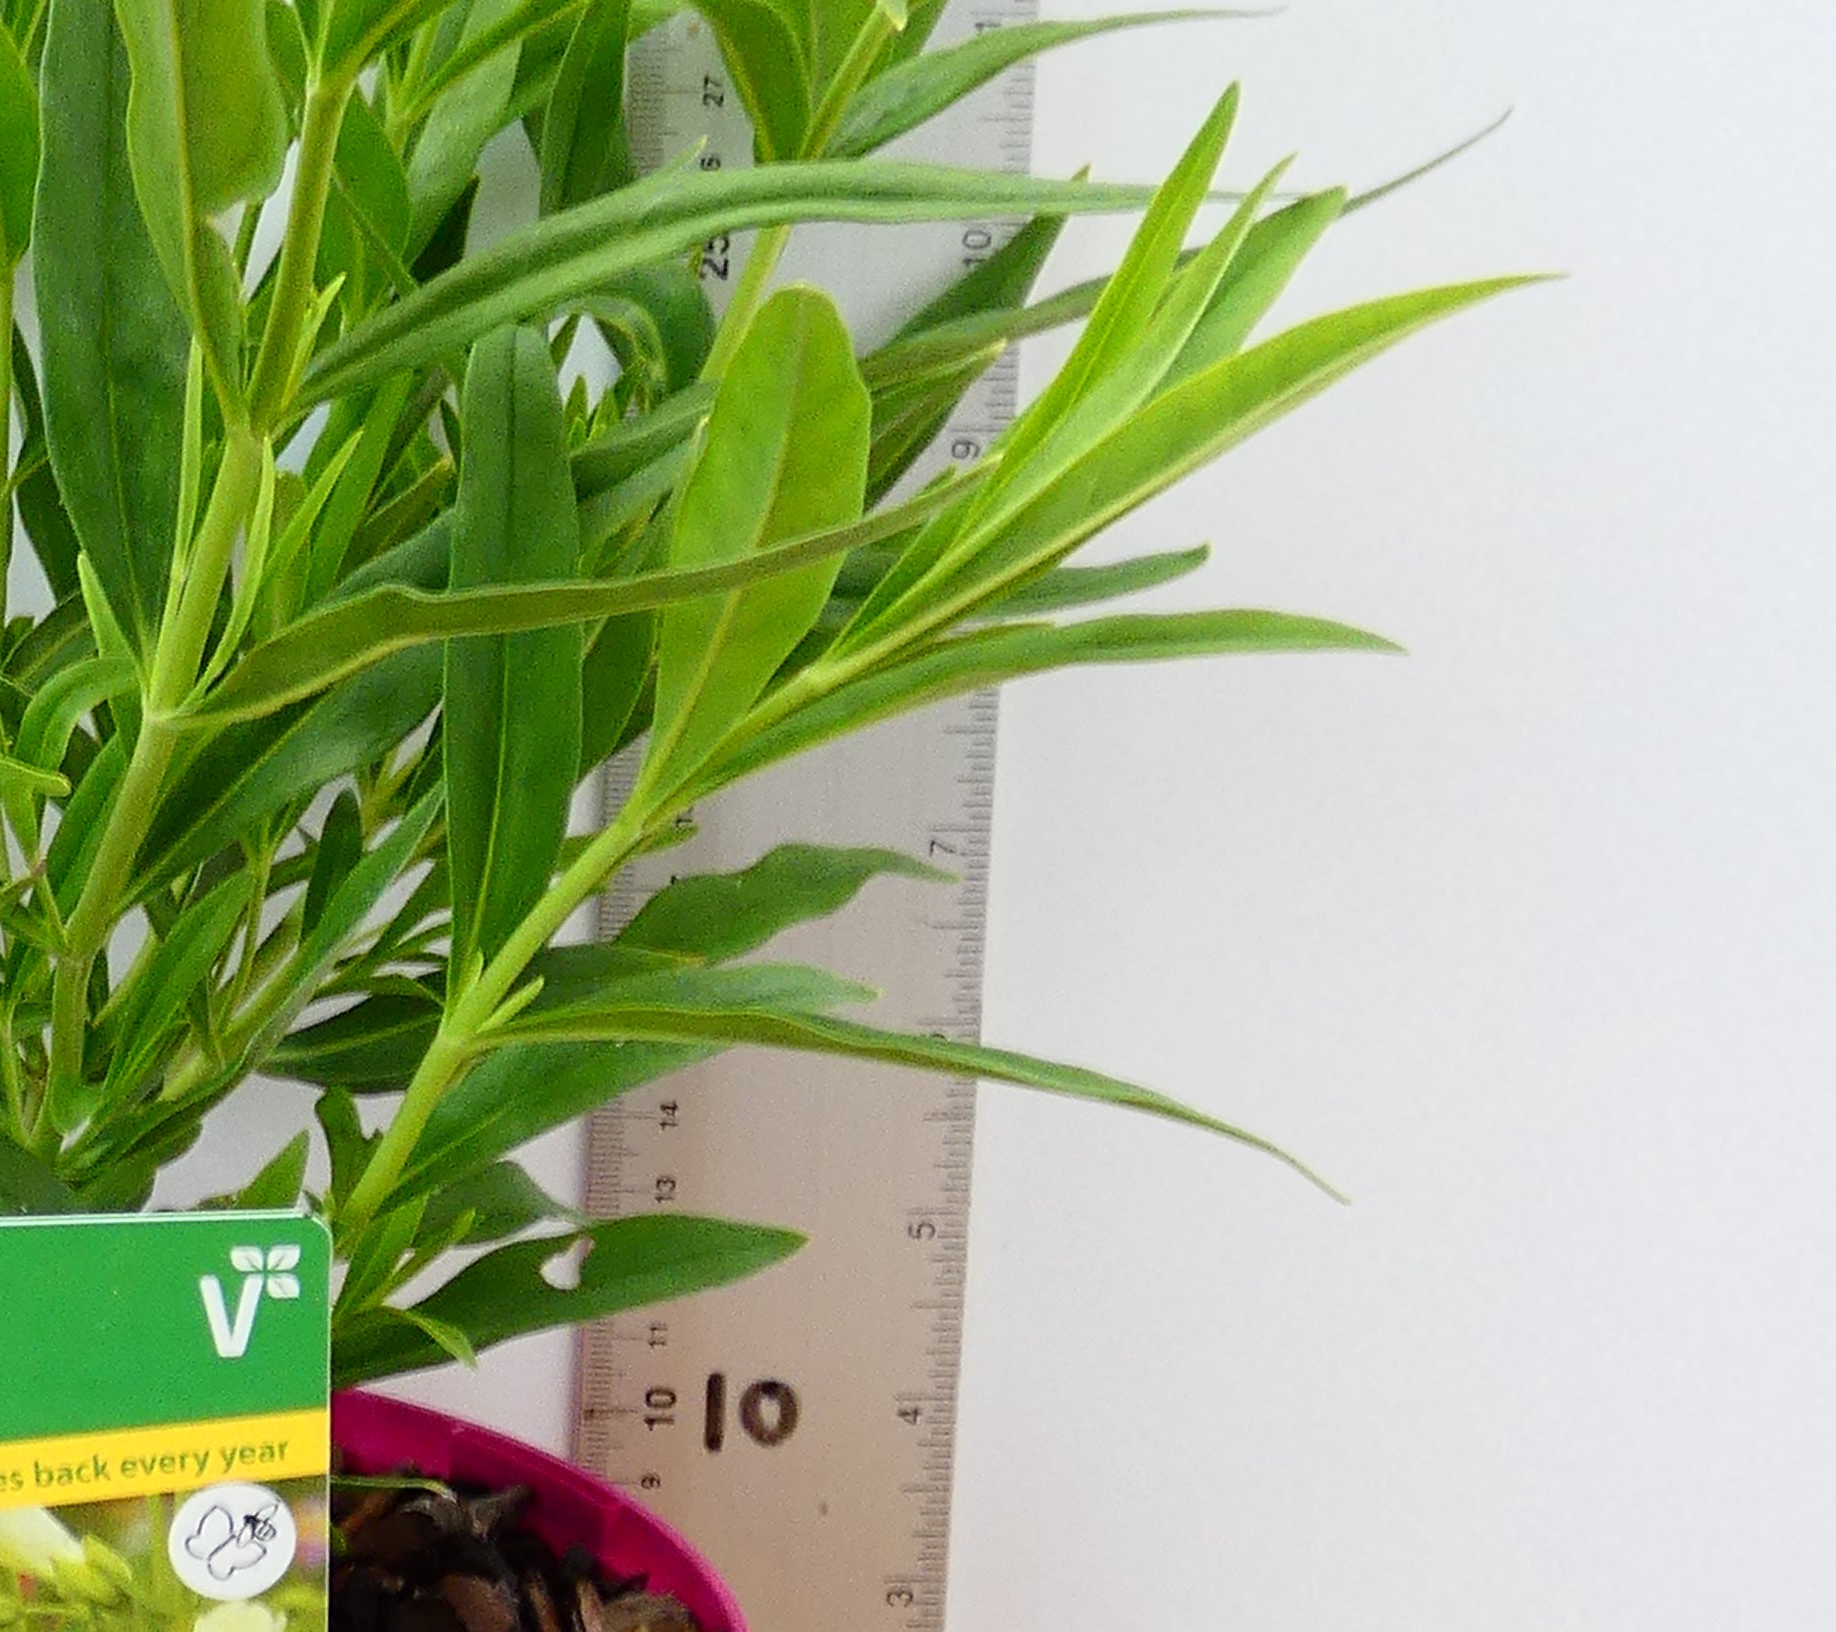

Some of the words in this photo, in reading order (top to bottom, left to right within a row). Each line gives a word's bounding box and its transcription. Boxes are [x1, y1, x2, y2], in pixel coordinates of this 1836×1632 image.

[701, 74, 726, 109] 27
[962, 228, 993, 267] 10
[952, 439, 979, 460] 9
[929, 838, 957, 857] 7
[659, 1101, 679, 1132] 14
[654, 1175, 678, 1205] 13
[908, 1220, 937, 1242] 5
[647, 1320, 670, 1350] 11
[644, 1385, 678, 1433] 10
[703, 1371, 800, 1454] 10
[896, 1404, 922, 1426] 4
[33, 1455, 111, 1489] back
[119, 1448, 211, 1480] every
[219, 1438, 289, 1474] year
[640, 1471, 663, 1491] 9
[886, 1586, 915, 1609] 3
